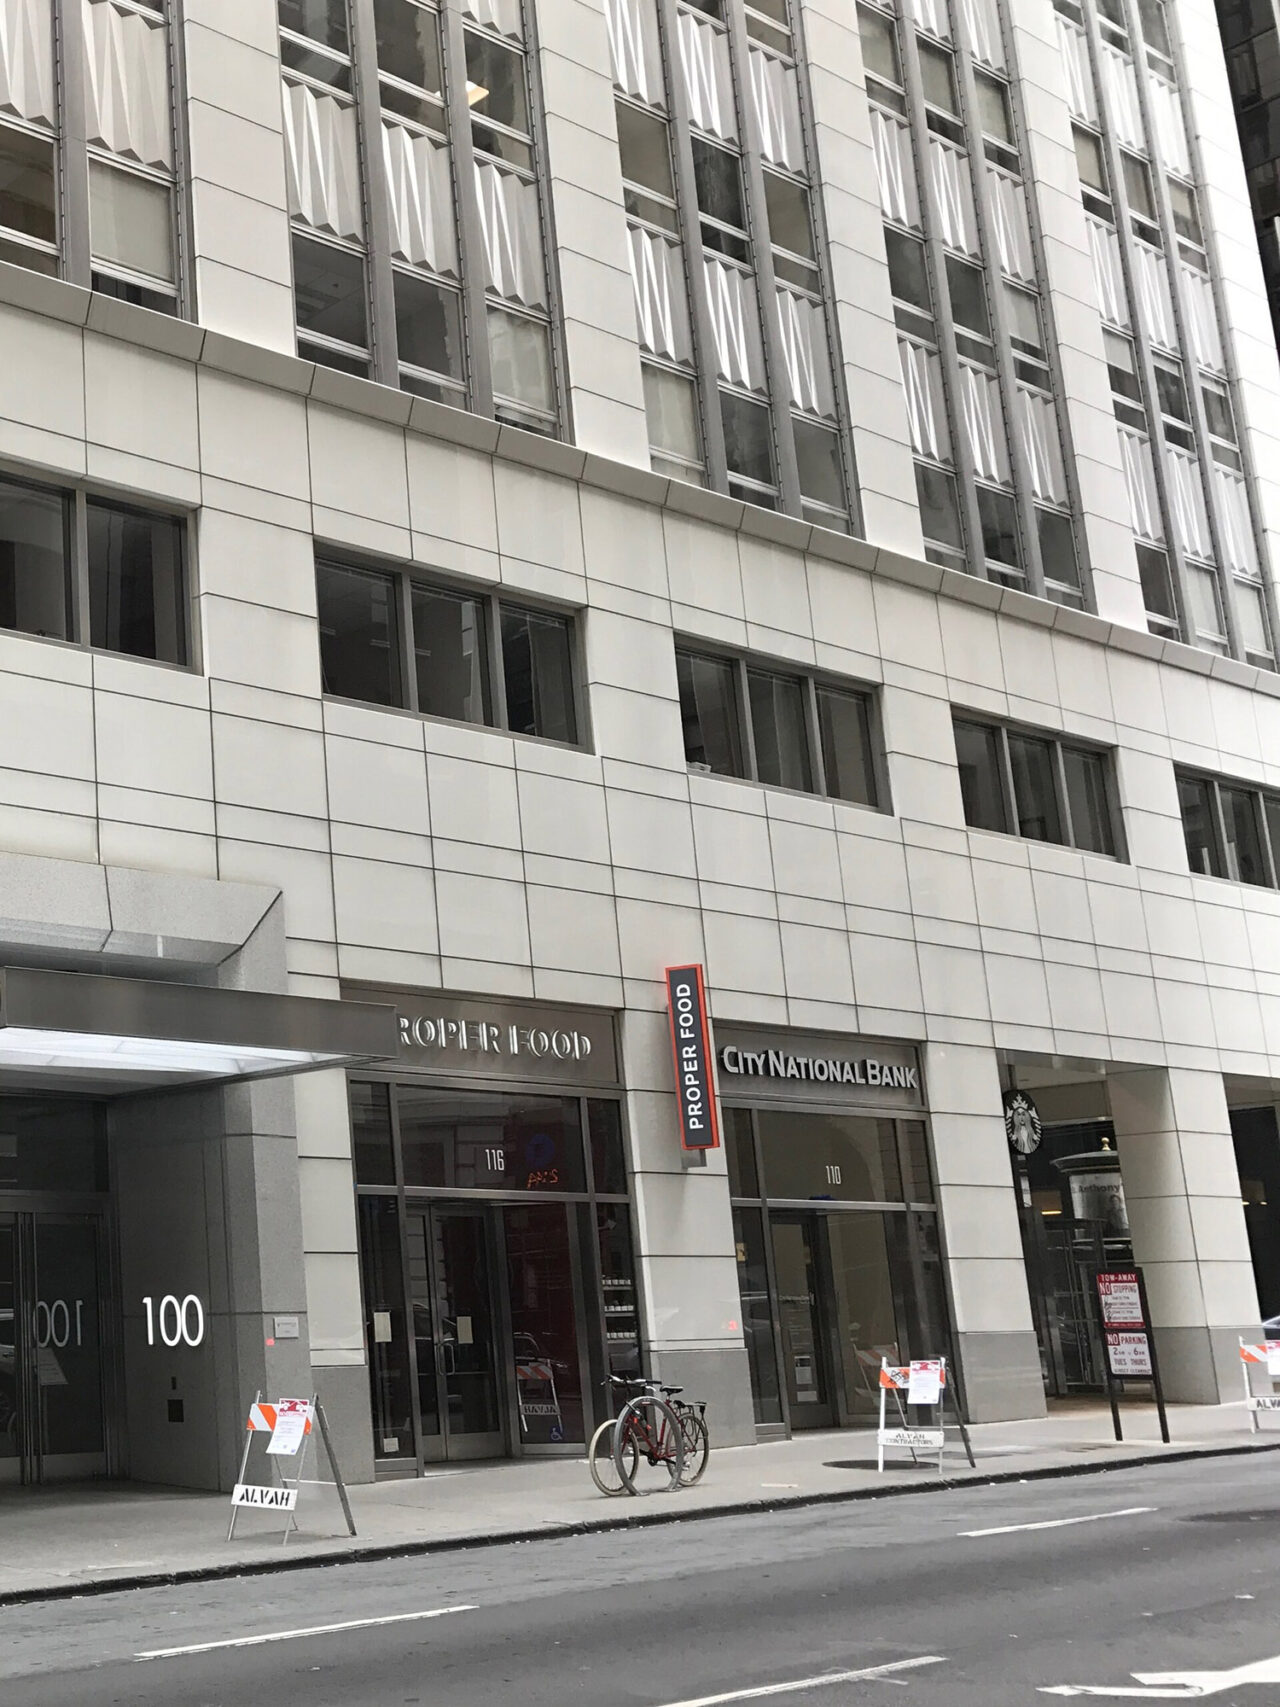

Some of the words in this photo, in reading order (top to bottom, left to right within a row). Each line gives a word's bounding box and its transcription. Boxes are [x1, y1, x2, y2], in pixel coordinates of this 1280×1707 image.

[676, 983, 696, 1039] FOOD
[399, 1016, 500, 1053] ROPER
[508, 1024, 592, 1060] FOOD
[682, 1044, 704, 1130] PROPER
[485, 1149, 505, 1171] 116
[825, 1165, 842, 1185] 110
[1100, 1273, 1136, 1281] TOW-AWAY
[1100, 1282, 1111, 1294] NO
[142, 1294, 204, 1347] 100
[1107, 1333, 1119, 1345] NO
[1120, 1336, 1147, 1345] PARKING
[239, 1487, 290, 1507] ALVAH
